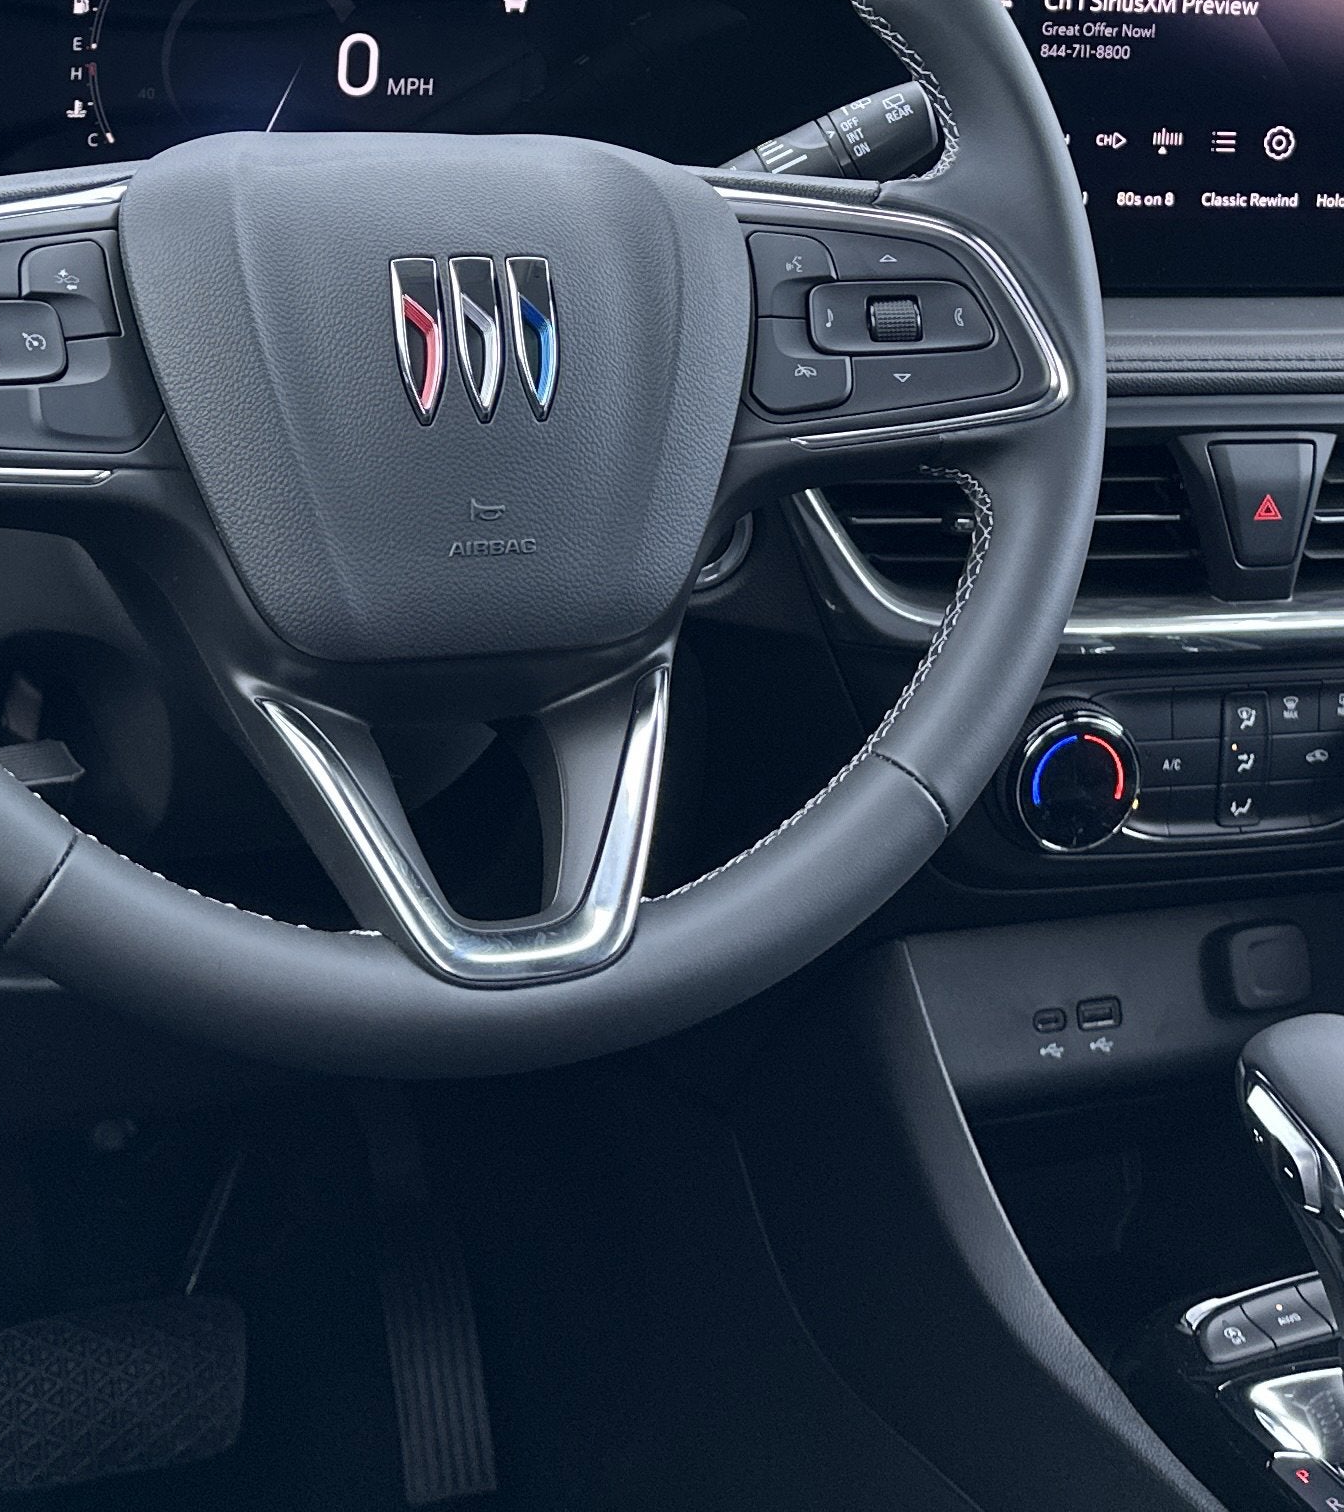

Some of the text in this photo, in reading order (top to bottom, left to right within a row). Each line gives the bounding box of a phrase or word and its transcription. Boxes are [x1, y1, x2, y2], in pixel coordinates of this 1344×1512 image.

[1042, 21, 1156, 38] Great Offer Now!
[72, 37, 83, 51] E
[1040, 44, 1131, 60] 844-711-8800
[337, 32, 380, 96] 0
[70, 67, 82, 80] H
[387, 78, 434, 96] MPH
[885, 104, 914, 124] REAR
[840, 116, 860, 132] OFF
[87, 133, 99, 147] C
[846, 128, 865, 144] INT
[853, 142, 871, 157] ON
[1116, 192, 1175, 207] 80s on 8
[1201, 192, 1299, 208] Classic Rewind
[449, 537, 537, 558] AIRBAG
[1162, 758, 1181, 771] A/C
[1295, 1469, 1310, 1484] P
[1325, 1497, 1344, 1512] R
